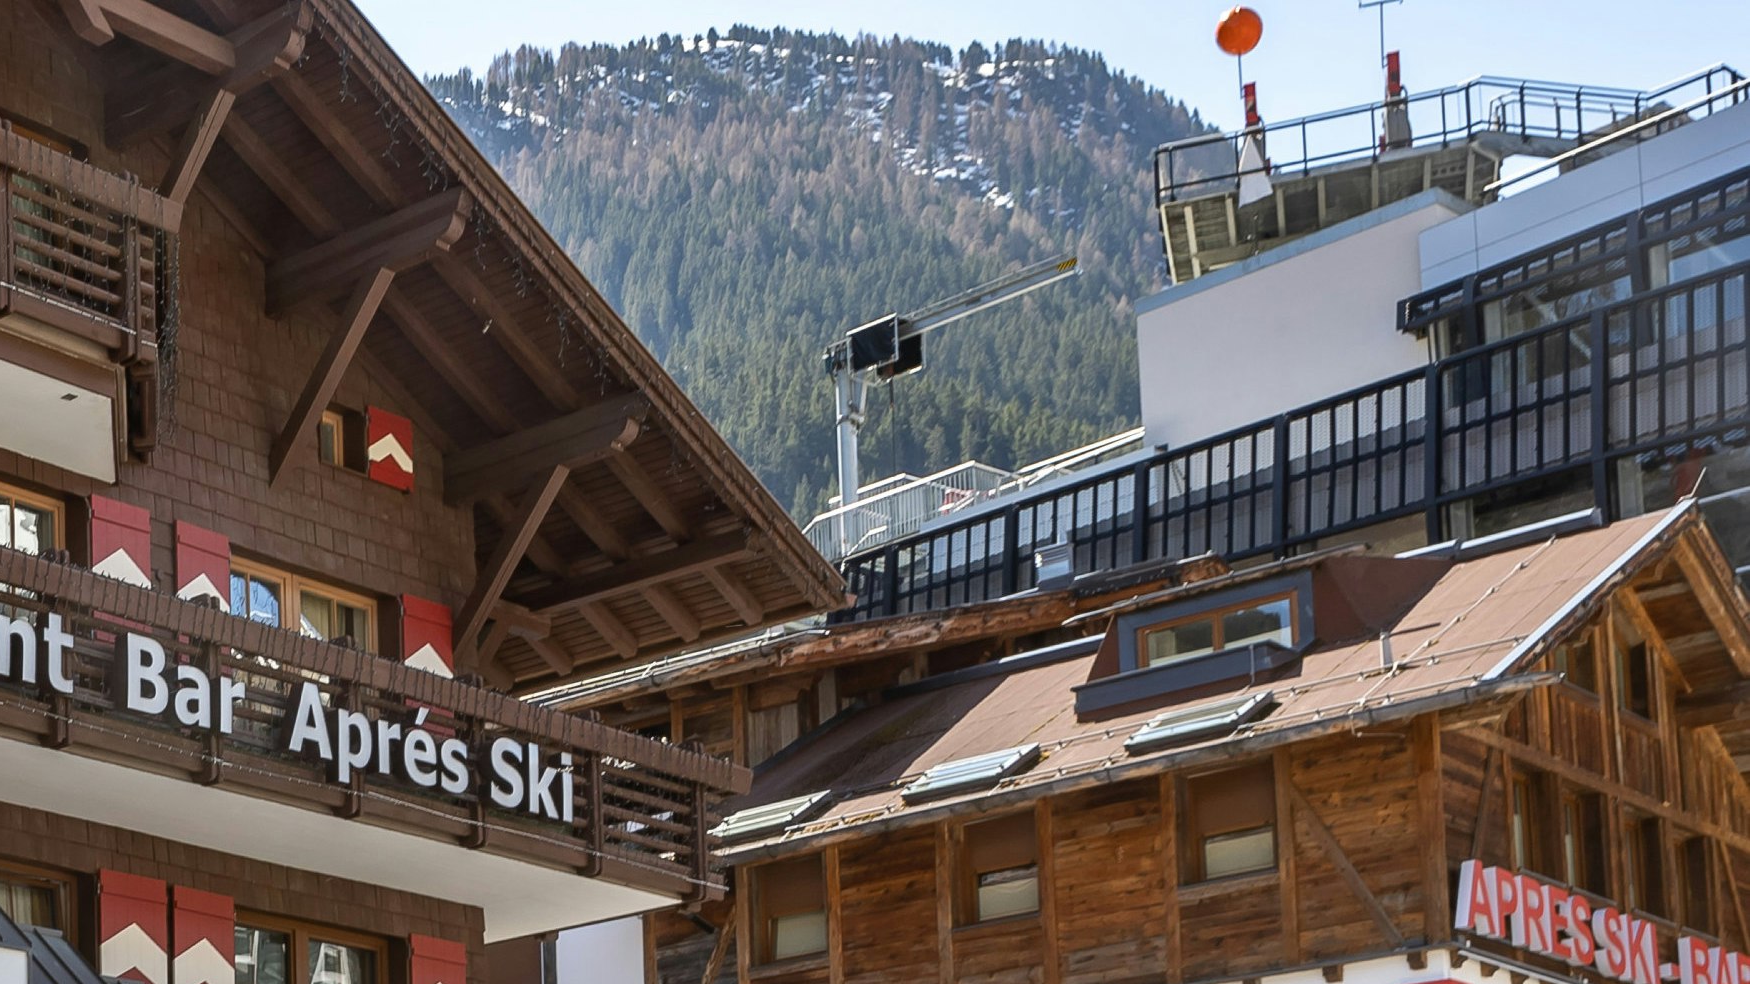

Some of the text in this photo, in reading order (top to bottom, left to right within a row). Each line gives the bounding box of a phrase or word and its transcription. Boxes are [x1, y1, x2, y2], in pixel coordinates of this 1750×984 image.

[126, 632, 246, 734] Bar
[289, 682, 469, 794] Aprés
[490, 736, 574, 823] Ski
[1455, 859, 1595, 966] APRES
